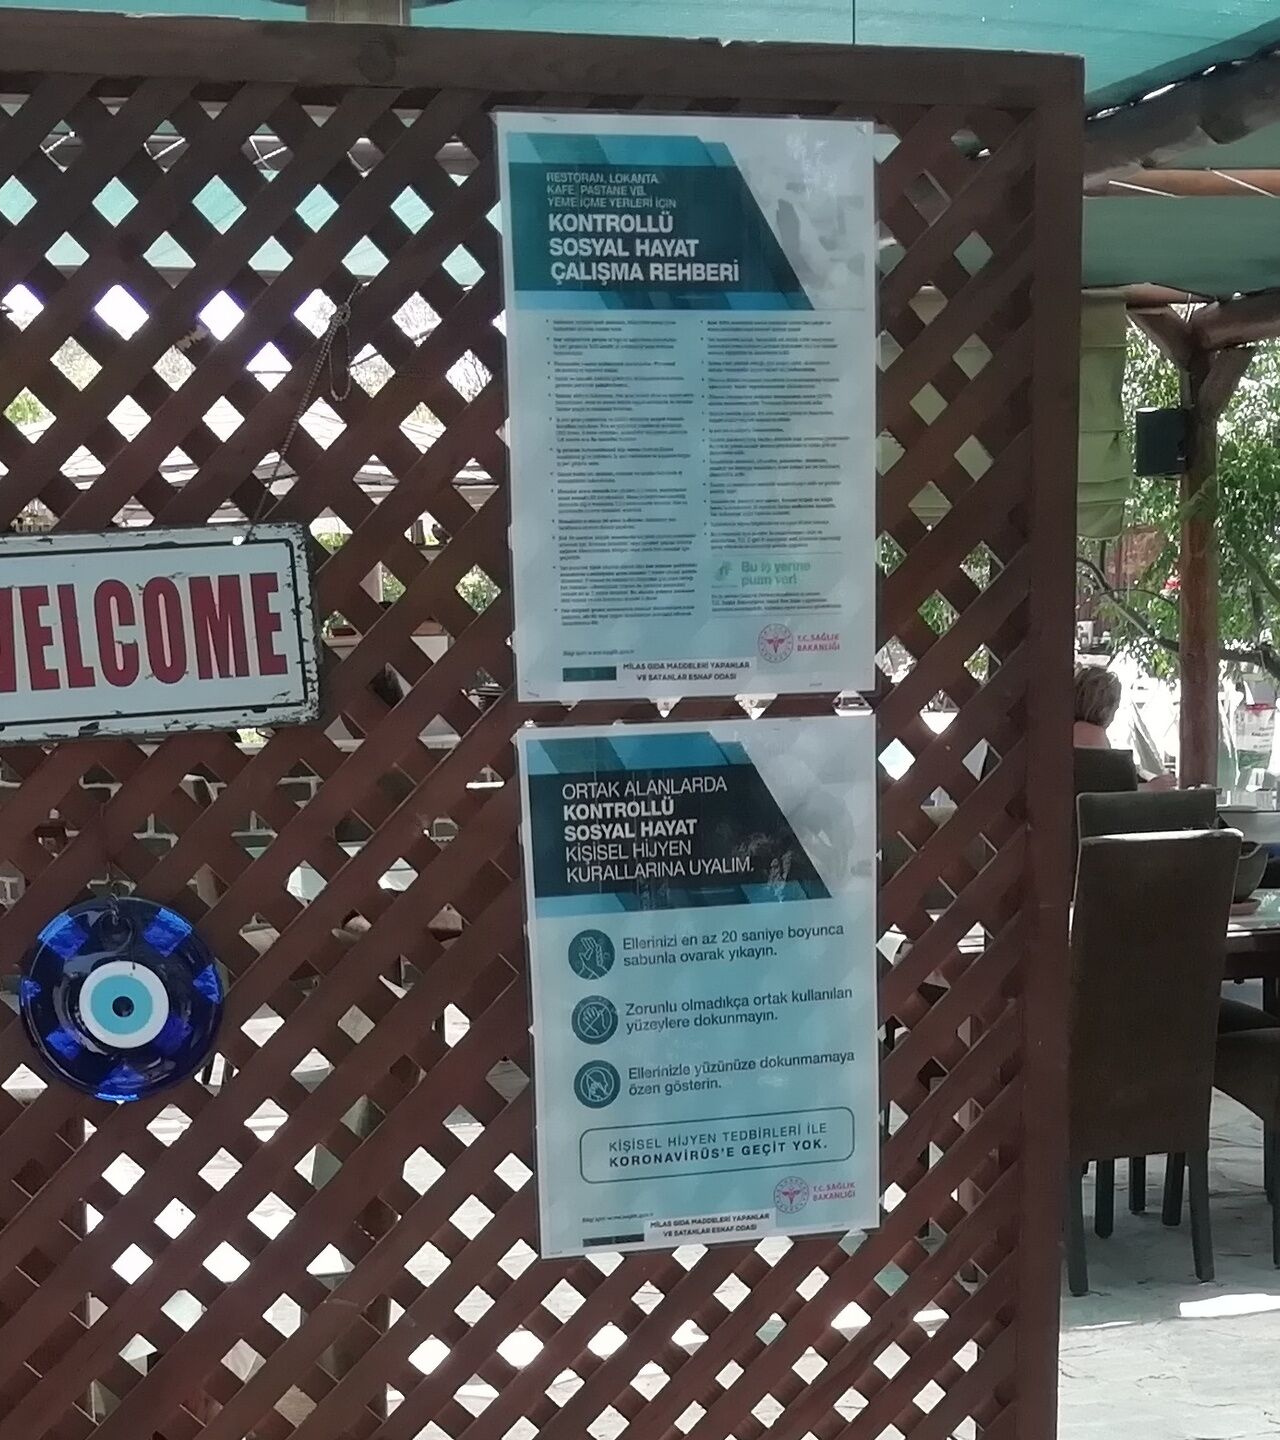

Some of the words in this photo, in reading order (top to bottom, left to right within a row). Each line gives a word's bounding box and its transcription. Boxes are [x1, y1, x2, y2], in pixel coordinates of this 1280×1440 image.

[548, 197, 577, 208] YEME
[580, 185, 627, 196] PASTANE
[548, 211, 673, 233] KONTROLLÜ
[549, 238, 630, 257] SOSYAL
[635, 238, 699, 258] HAYAT
[551, 261, 644, 285] ÇALIŞMA
[649, 259, 739, 282] REHBERİ
[562, 781, 620, 801] ORTAK
[624, 776, 728, 798] ALANLARDA
[563, 797, 674, 821] KONTROLLÜ
[564, 823, 636, 842] SOSYAL
[641, 818, 698, 838] HAYAT
[566, 841, 629, 866] KİŞİSEL
[632, 839, 692, 859] HİJYEN
[566, 861, 685, 884] KURALLARINA
[690, 857, 755, 876] UYALIM.
[623, 936, 678, 950] Ellerinizi
[681, 936, 698, 946] en
[701, 935, 718, 945] az
[721, 931, 738, 943] 20
[741, 928, 784, 943] saniye
[788, 925, 844, 940] boyunca
[623, 951, 676, 967] sabunla
[680, 948, 724, 963] ovarak
[728, 945, 778, 962] yıkayın.
[625, 1001, 677, 1016] Zorunlu
[681, 996, 749, 1013] olmadıkça
[753, 993, 788, 1006] ortak
[791, 987, 853, 1003] kullanılan
[626, 1017, 690, 1035] yüzeylere
[694, 1010, 778, 1027] dokunmayın.
[628, 1064, 691, 1080] Ellerinizle
[694, 1058, 756, 1077] yüzünüze
[759, 1051, 855, 1069] dokunmamaya
[629, 1082, 661, 1096] özen
[664, 1078, 722, 1096] gösterin.
[608, 1136, 662, 1154] KİŞİSEL
[667, 1131, 717, 1147] HİJYEN
[722, 1123, 802, 1143] TEDBİRLERİ
[806, 1121, 828, 1135] İLE
[609, 1145, 736, 1168] KORONAVİRÜS'E
[741, 1140, 786, 1158] GEÇİT
[792, 1138, 828, 1152] YOK.
